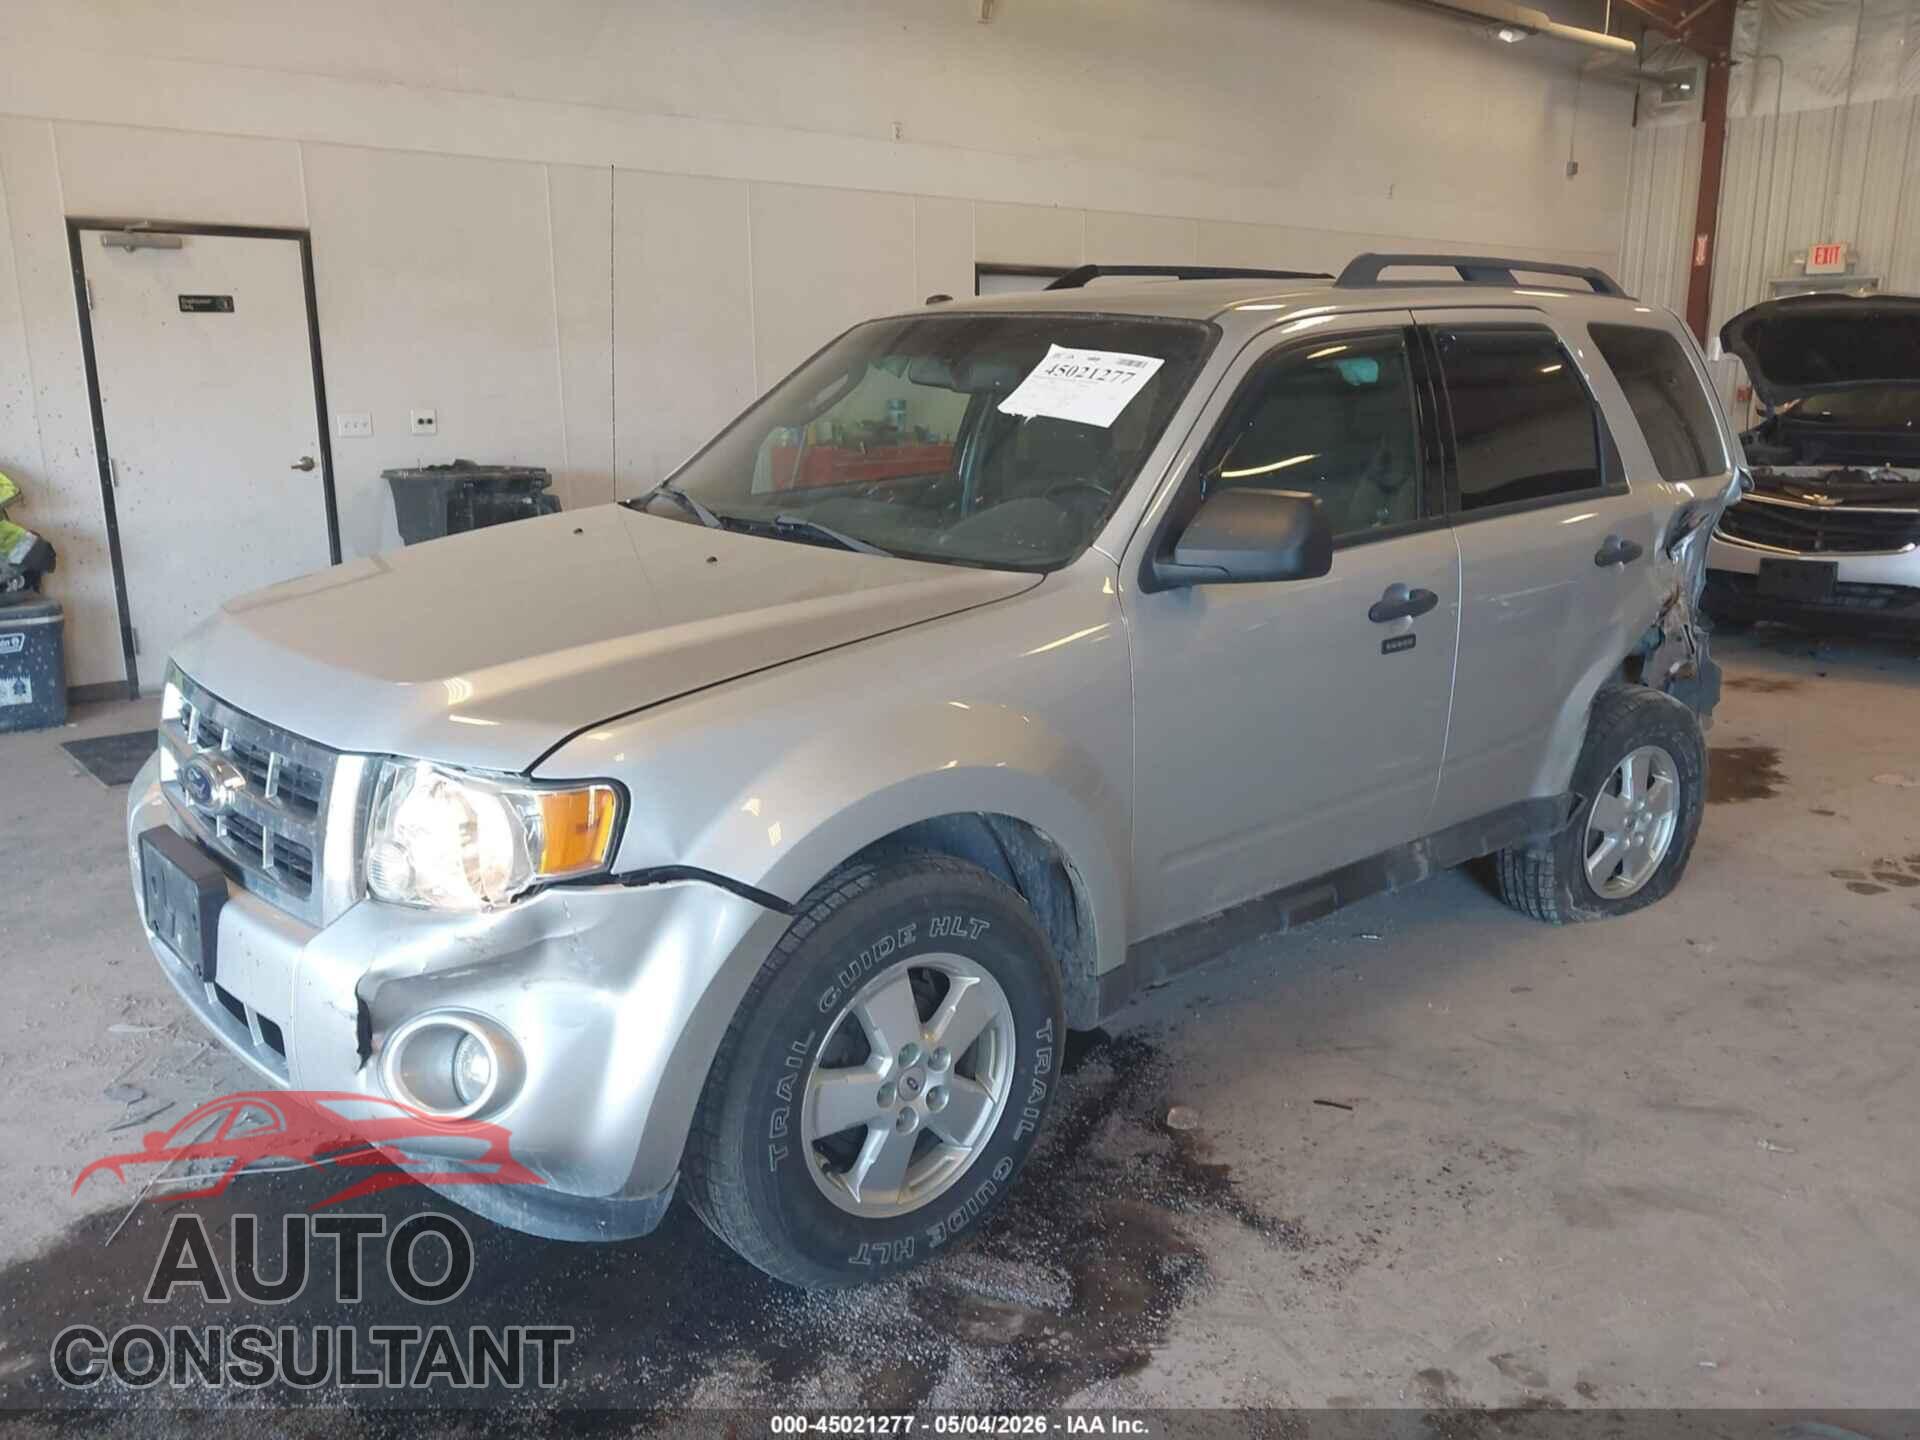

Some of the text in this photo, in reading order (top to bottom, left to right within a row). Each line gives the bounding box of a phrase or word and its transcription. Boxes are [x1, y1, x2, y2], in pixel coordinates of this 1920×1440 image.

[1814, 246, 1841, 264] EXIT
[1045, 362, 1137, 384] 45021277
[769, 914, 991, 1171] TRAIL GUIDE HLT
[848, 1017, 1054, 1266] TRAIL GUIDE HLT
